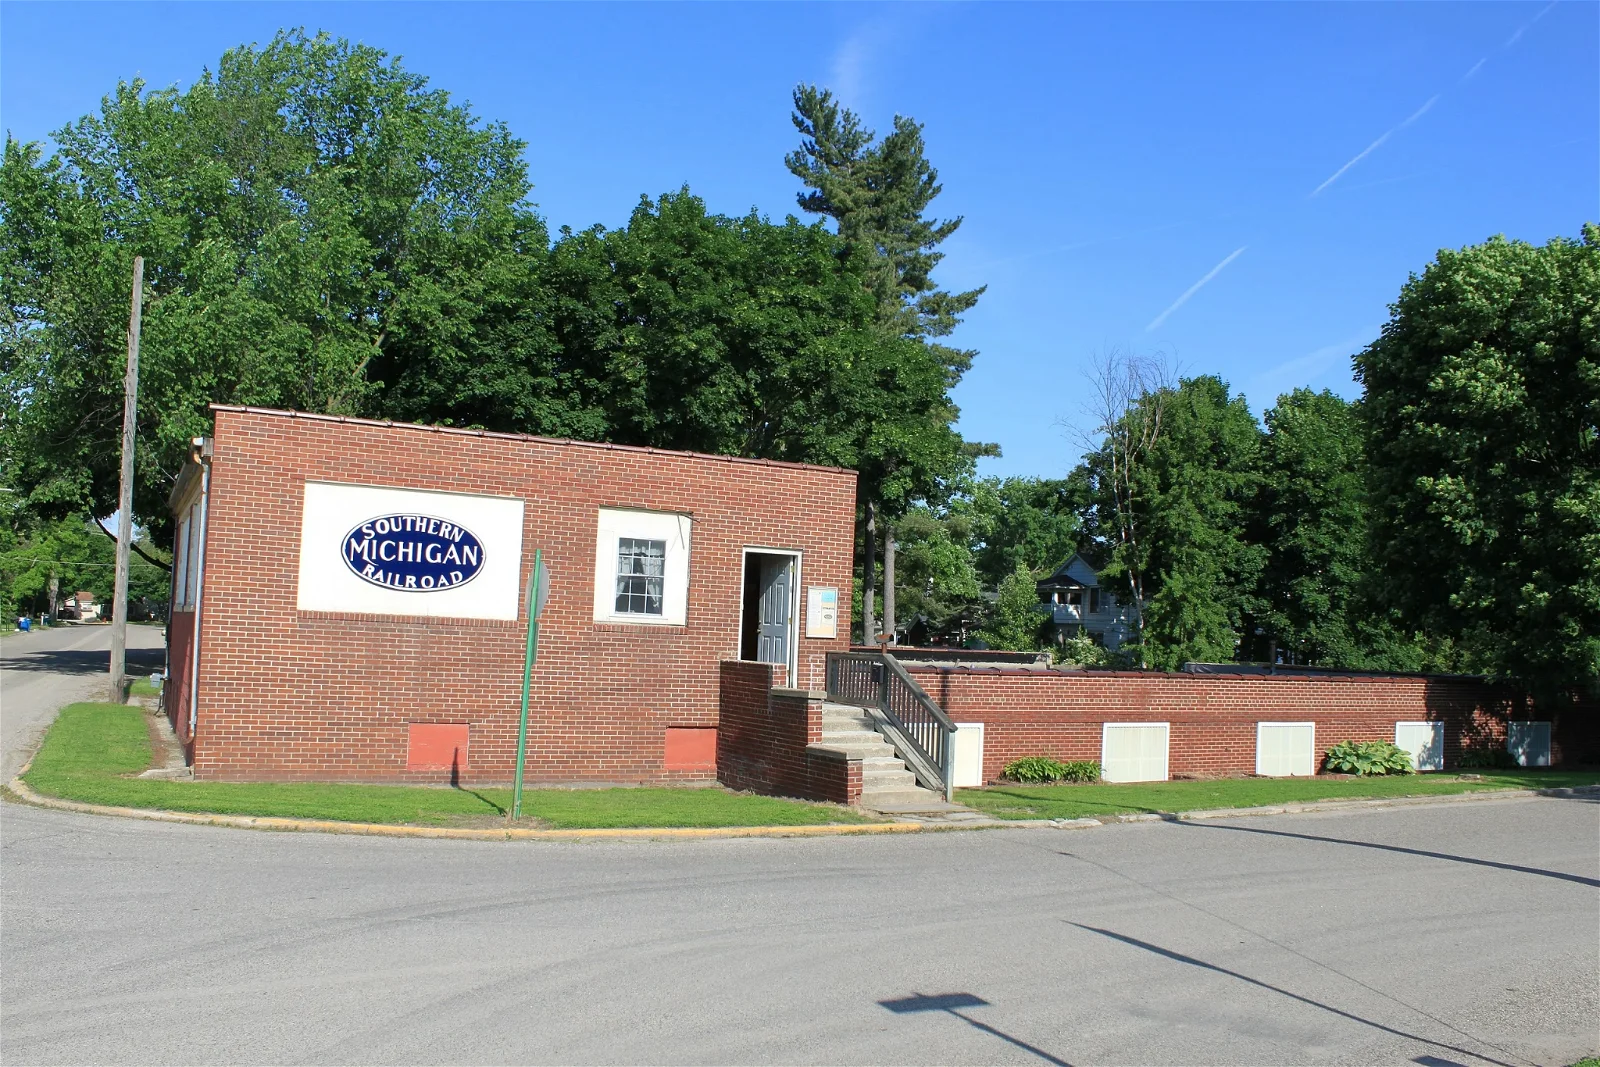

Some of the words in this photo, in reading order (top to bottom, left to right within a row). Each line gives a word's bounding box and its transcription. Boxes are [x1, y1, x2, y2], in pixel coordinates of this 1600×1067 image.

[362, 516, 464, 543] SOUTHERN
[350, 538, 478, 566] MICHIGAN
[362, 564, 463, 588] RAILROAD
